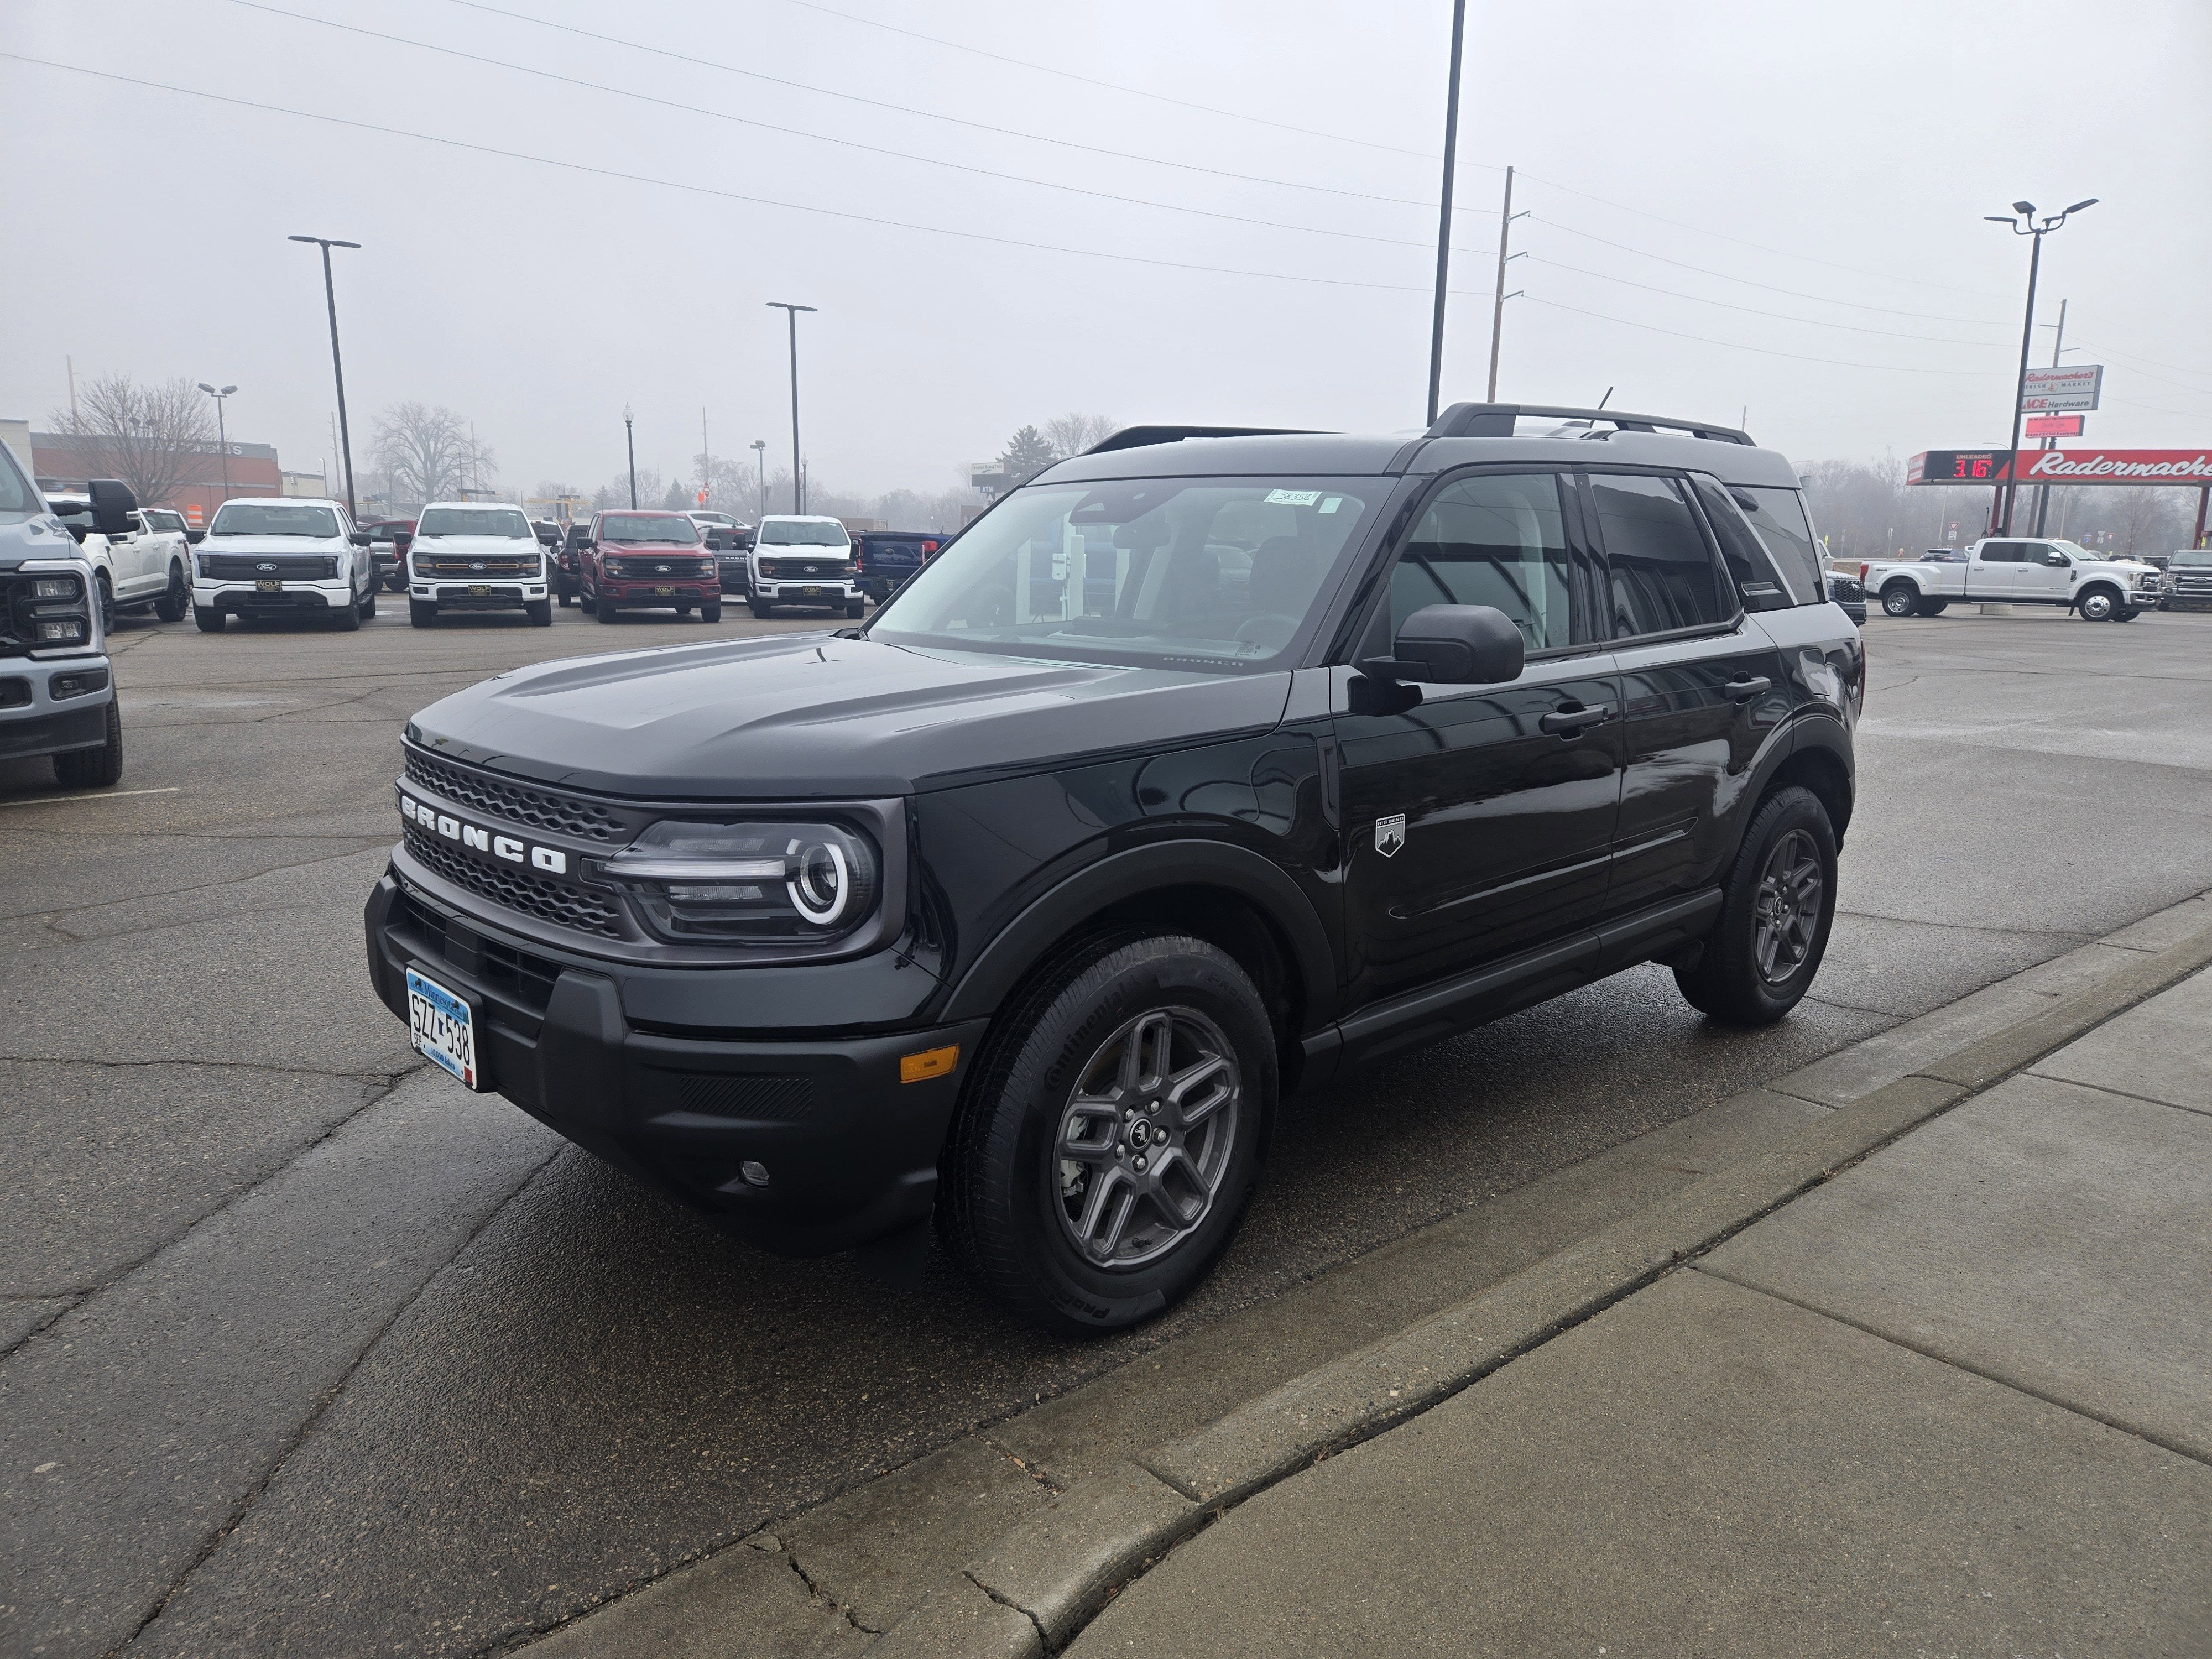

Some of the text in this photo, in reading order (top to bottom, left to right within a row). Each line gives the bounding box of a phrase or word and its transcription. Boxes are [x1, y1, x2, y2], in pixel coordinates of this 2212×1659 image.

[2025, 371, 2094, 382] Radermacher's
[2022, 399, 2048, 409] ACE
[402, 795, 566, 874] BRONCO
[424, 982, 454, 1011] Minnesota
[412, 994, 470, 1066] SZZ 538
[1044, 982, 1125, 1092] Continental
[431, 1047, 455, 1070] 10,000 lakes
